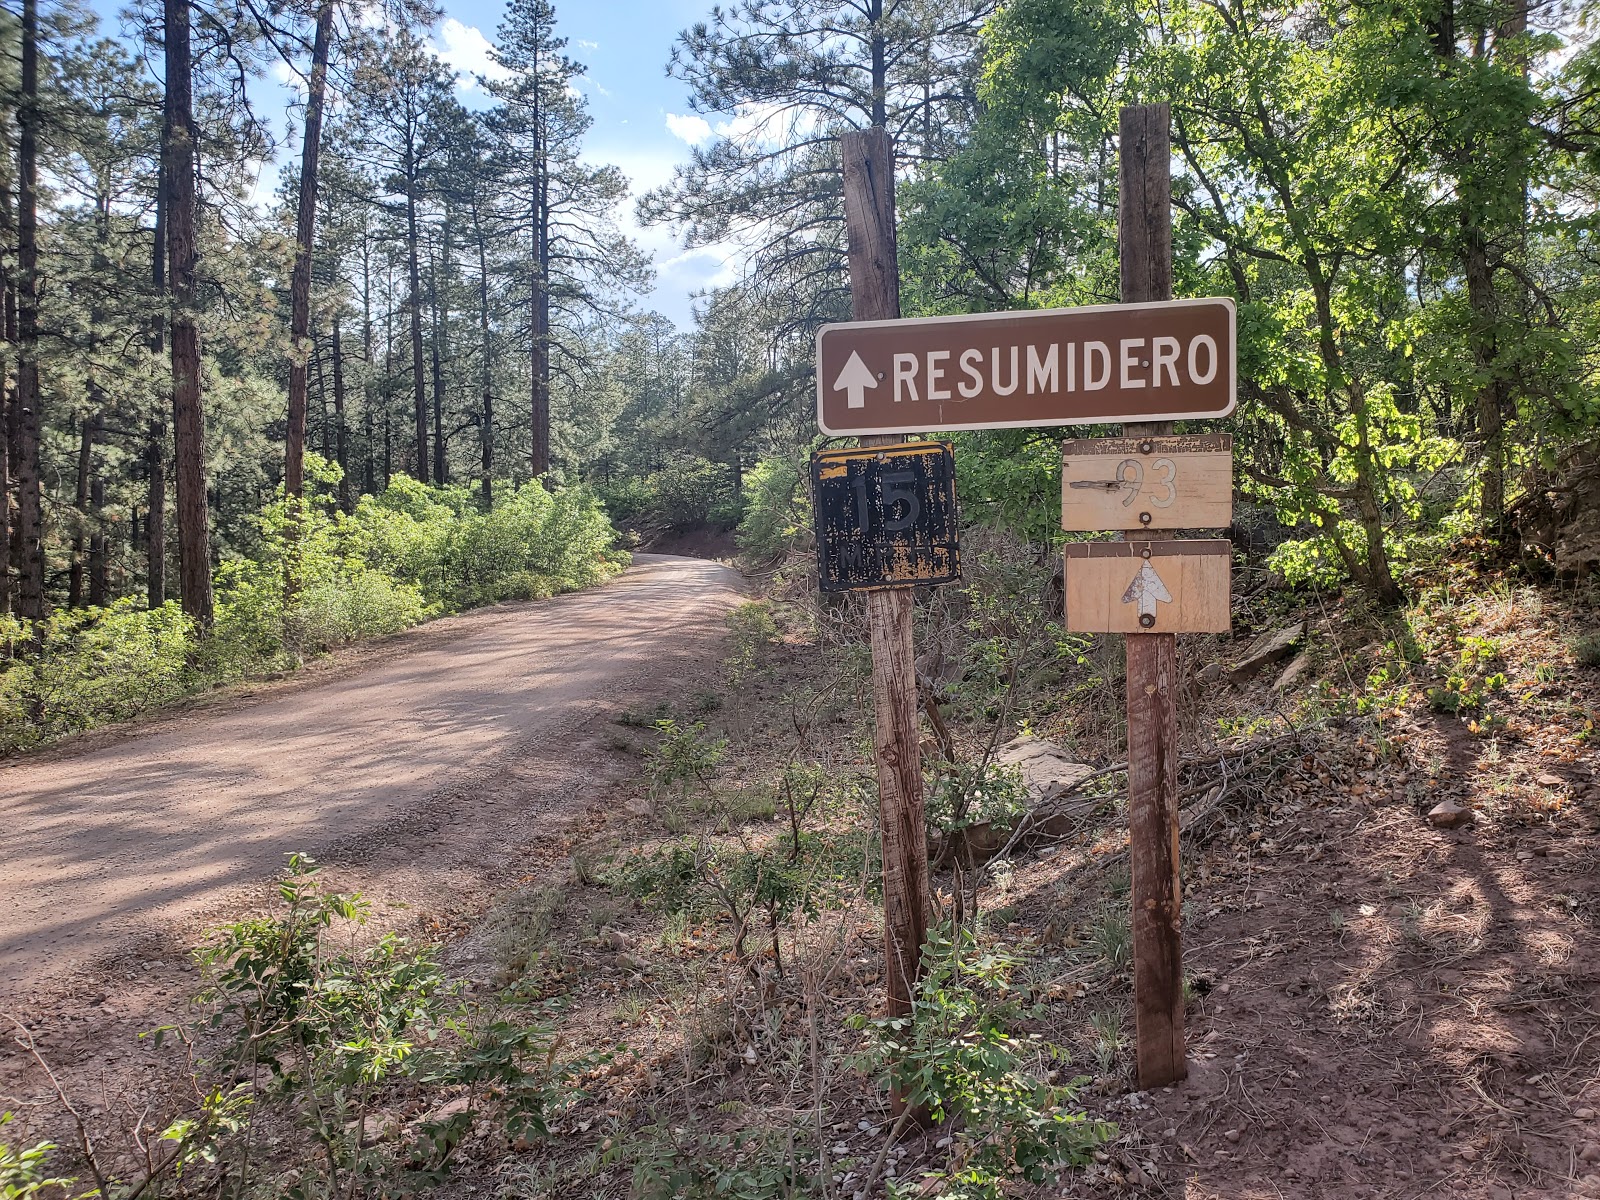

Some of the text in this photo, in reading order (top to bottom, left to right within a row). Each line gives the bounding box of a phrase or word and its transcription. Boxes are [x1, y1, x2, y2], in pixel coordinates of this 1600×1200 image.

[893, 334, 1218, 403] RESUMIDERO
[852, 472, 920, 533] 15
[1116, 458, 1177, 509] 93
